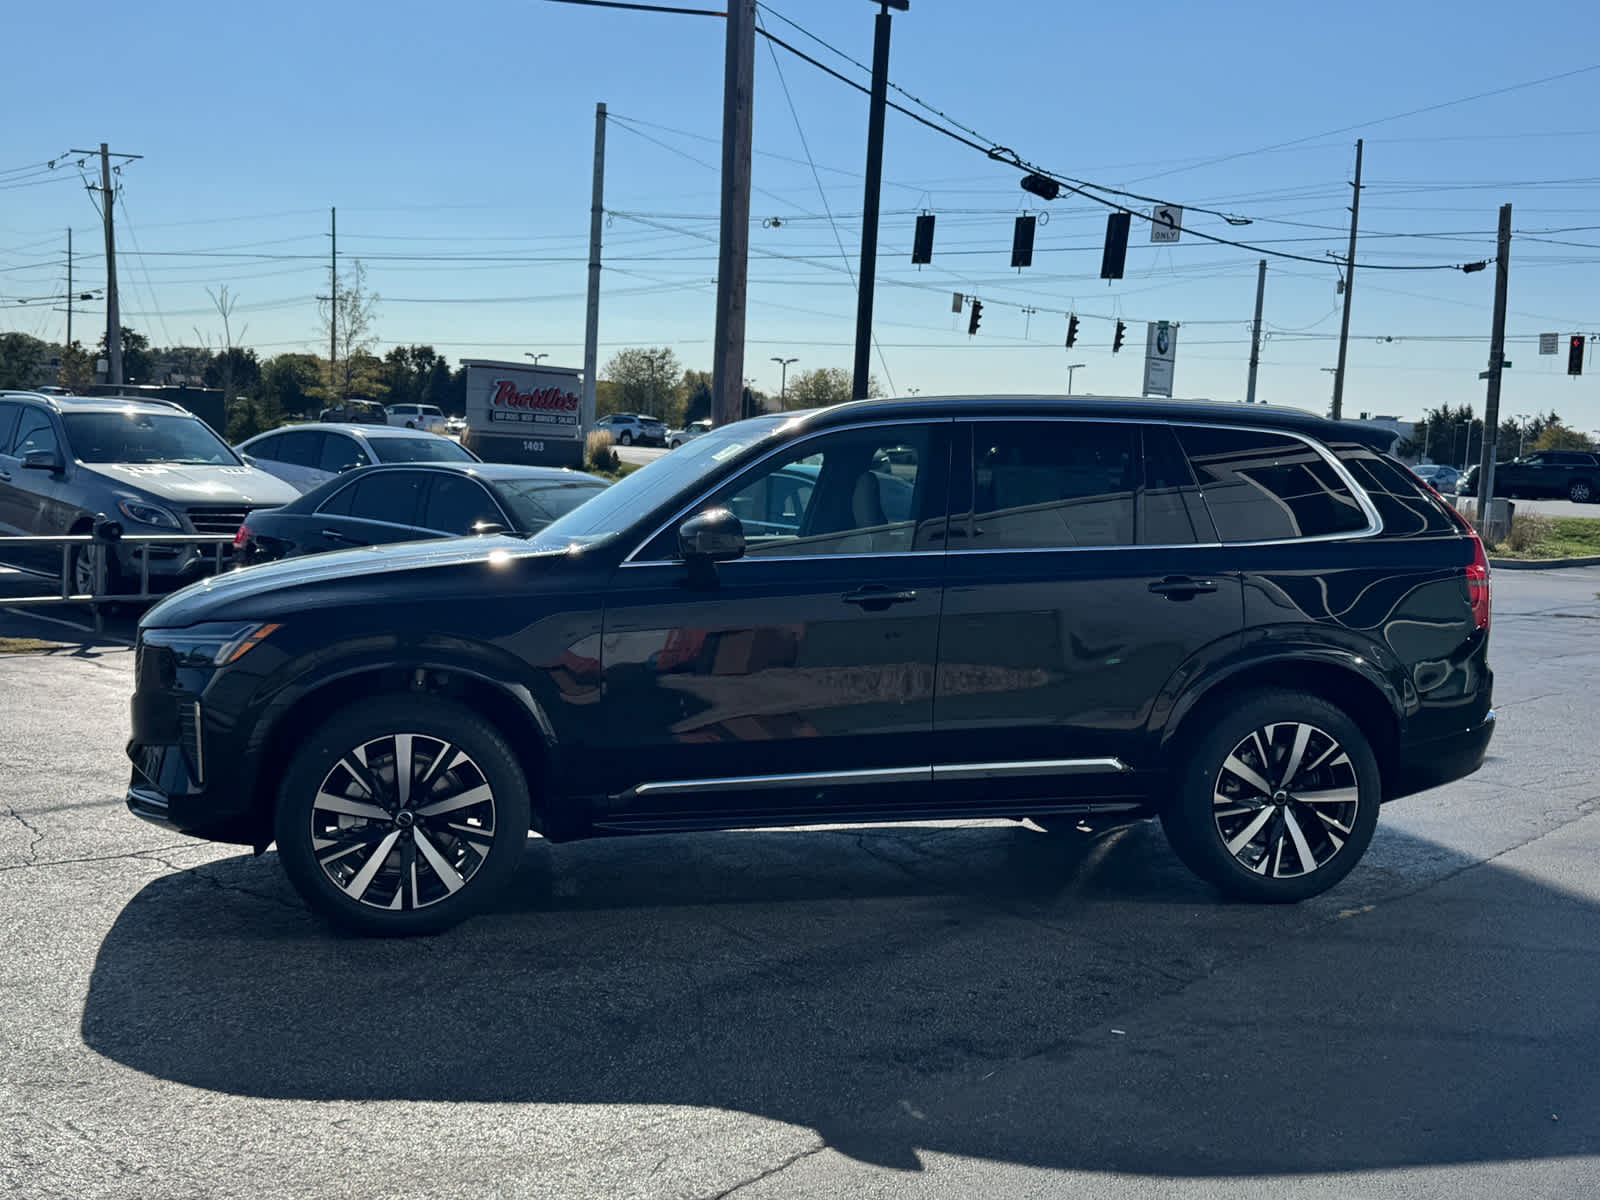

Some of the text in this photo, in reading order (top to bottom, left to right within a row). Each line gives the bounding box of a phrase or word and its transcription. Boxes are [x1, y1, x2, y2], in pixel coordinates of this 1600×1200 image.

[1154, 231, 1176, 240] ONLY
[494, 380, 579, 411] Portillo's
[523, 441, 545, 452] 1403
